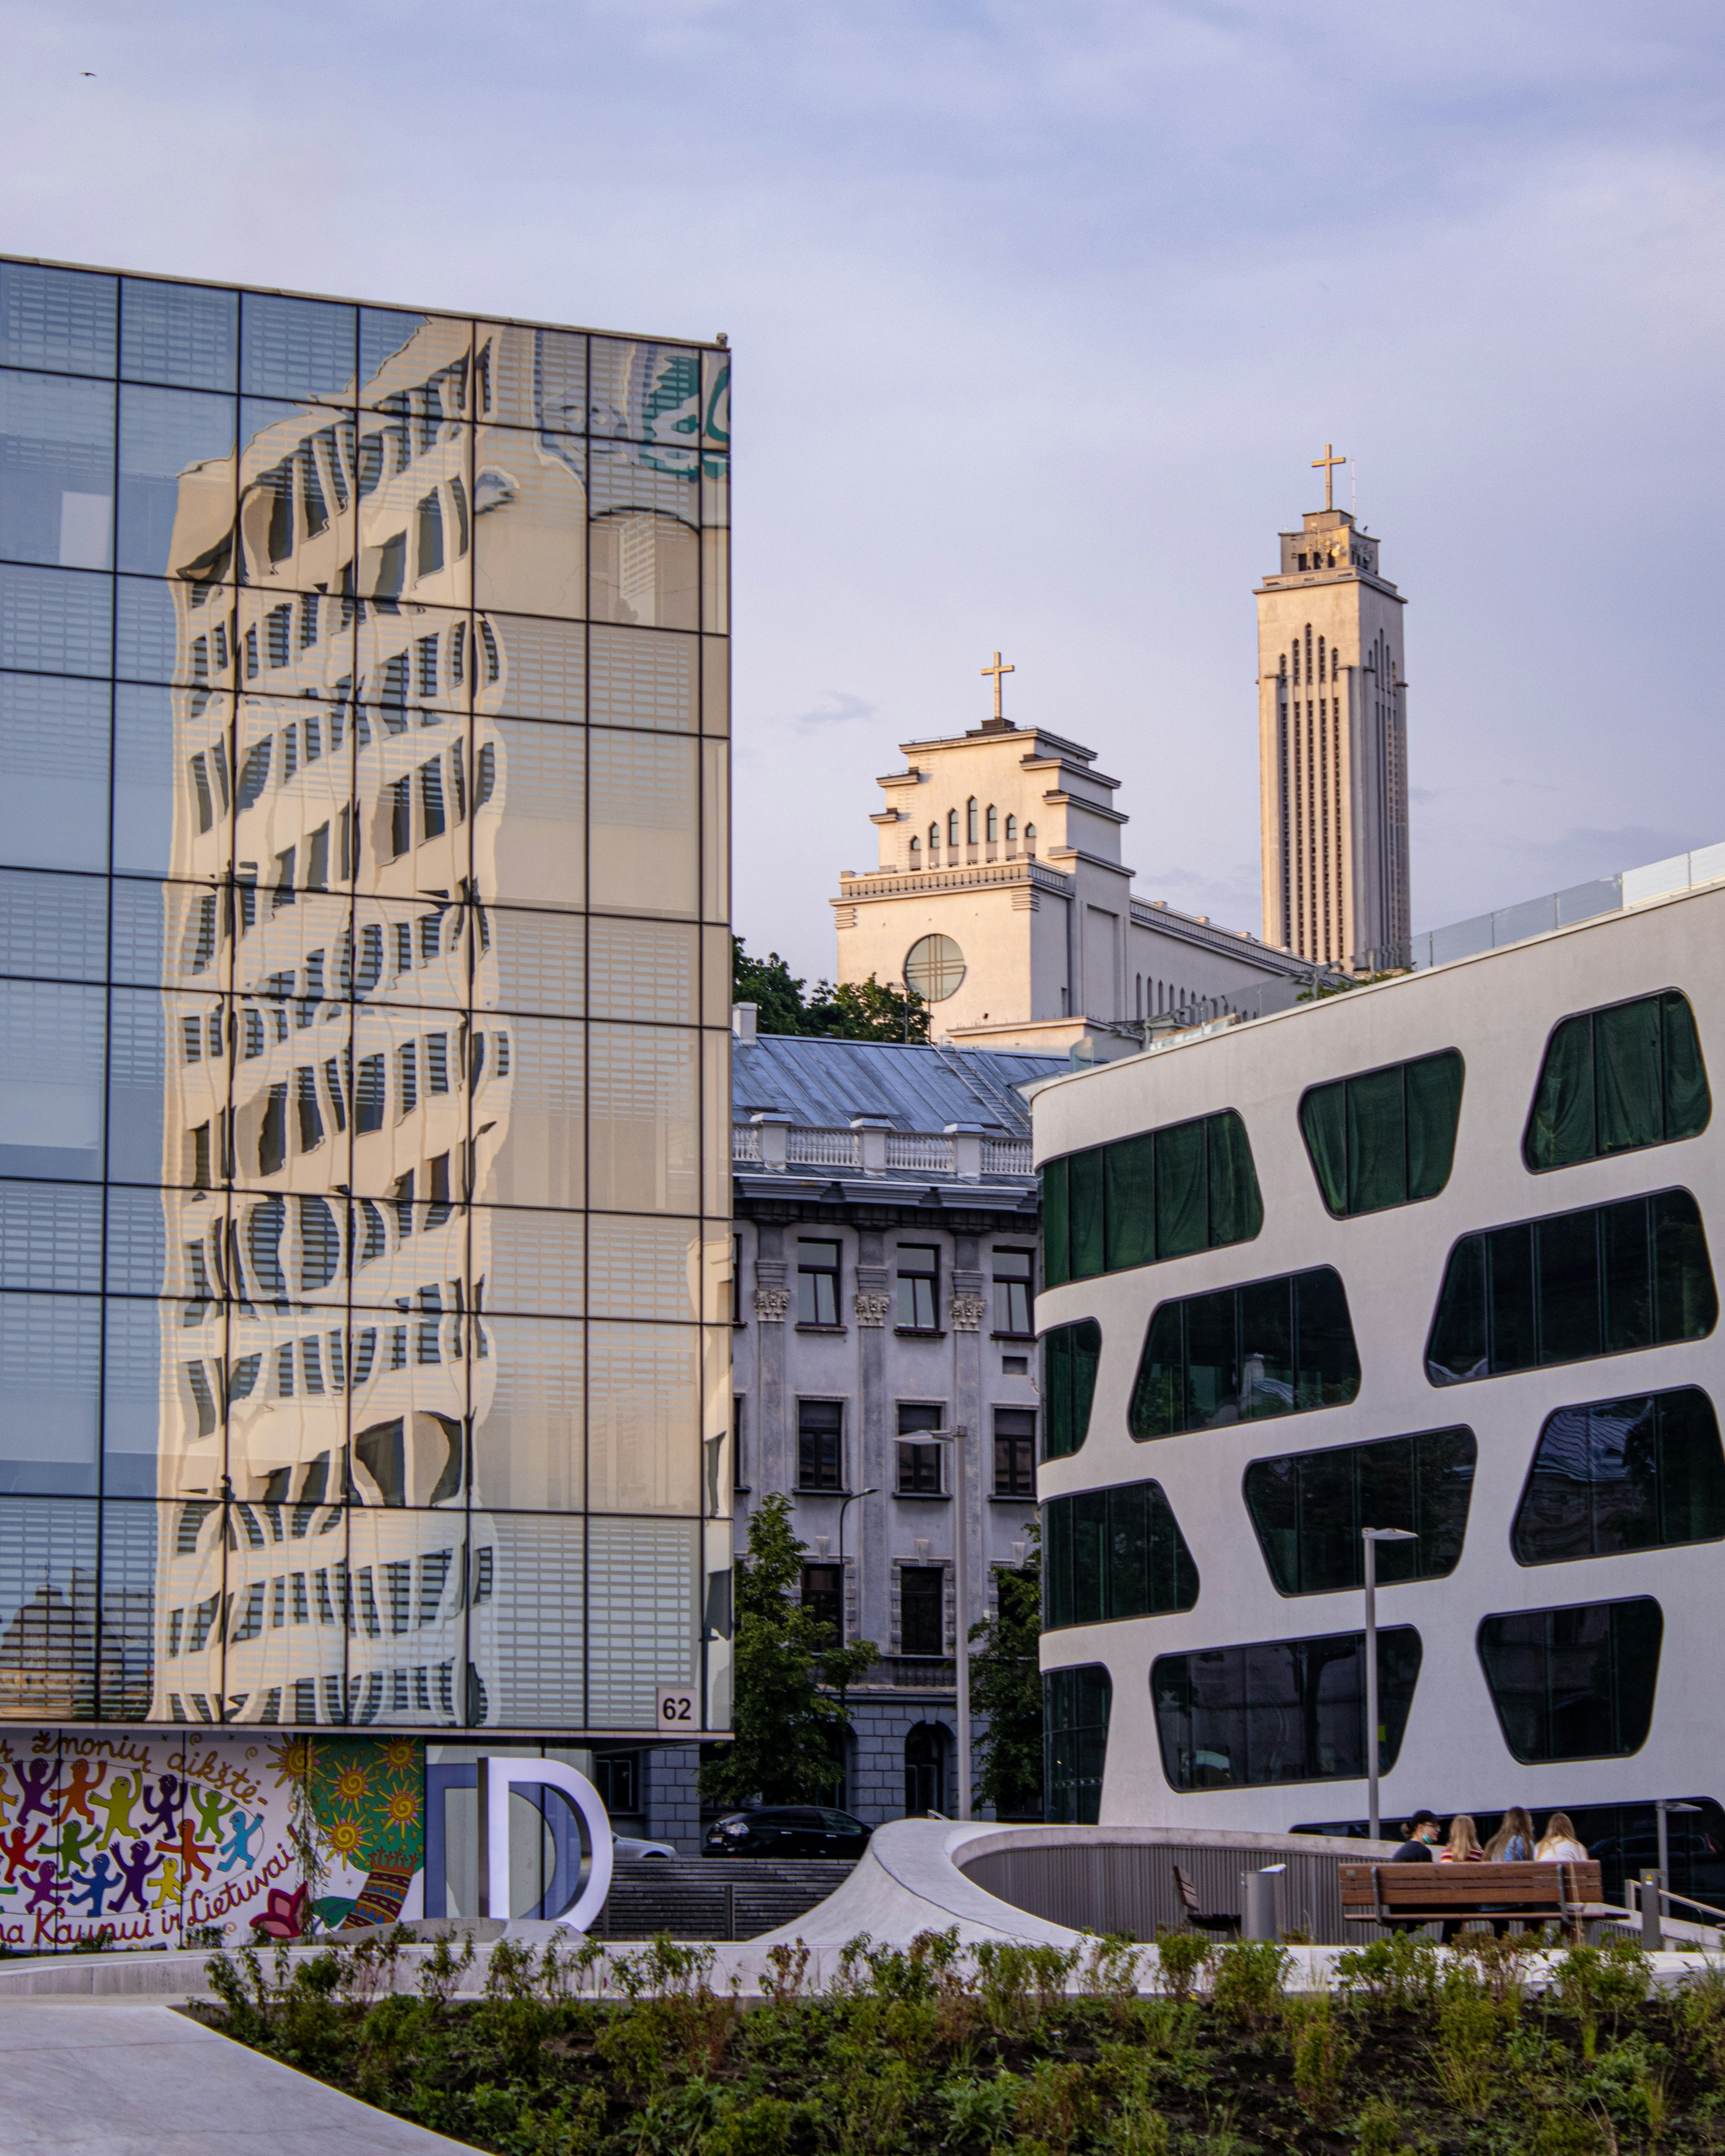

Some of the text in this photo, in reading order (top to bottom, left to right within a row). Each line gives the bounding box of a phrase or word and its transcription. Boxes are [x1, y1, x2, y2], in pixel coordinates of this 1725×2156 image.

[663, 1697, 691, 1720] 62
[31, 1730, 152, 1774] žmonių
[33, 1907, 154, 1945] Kaunui
[161, 1909, 184, 1931] ir
